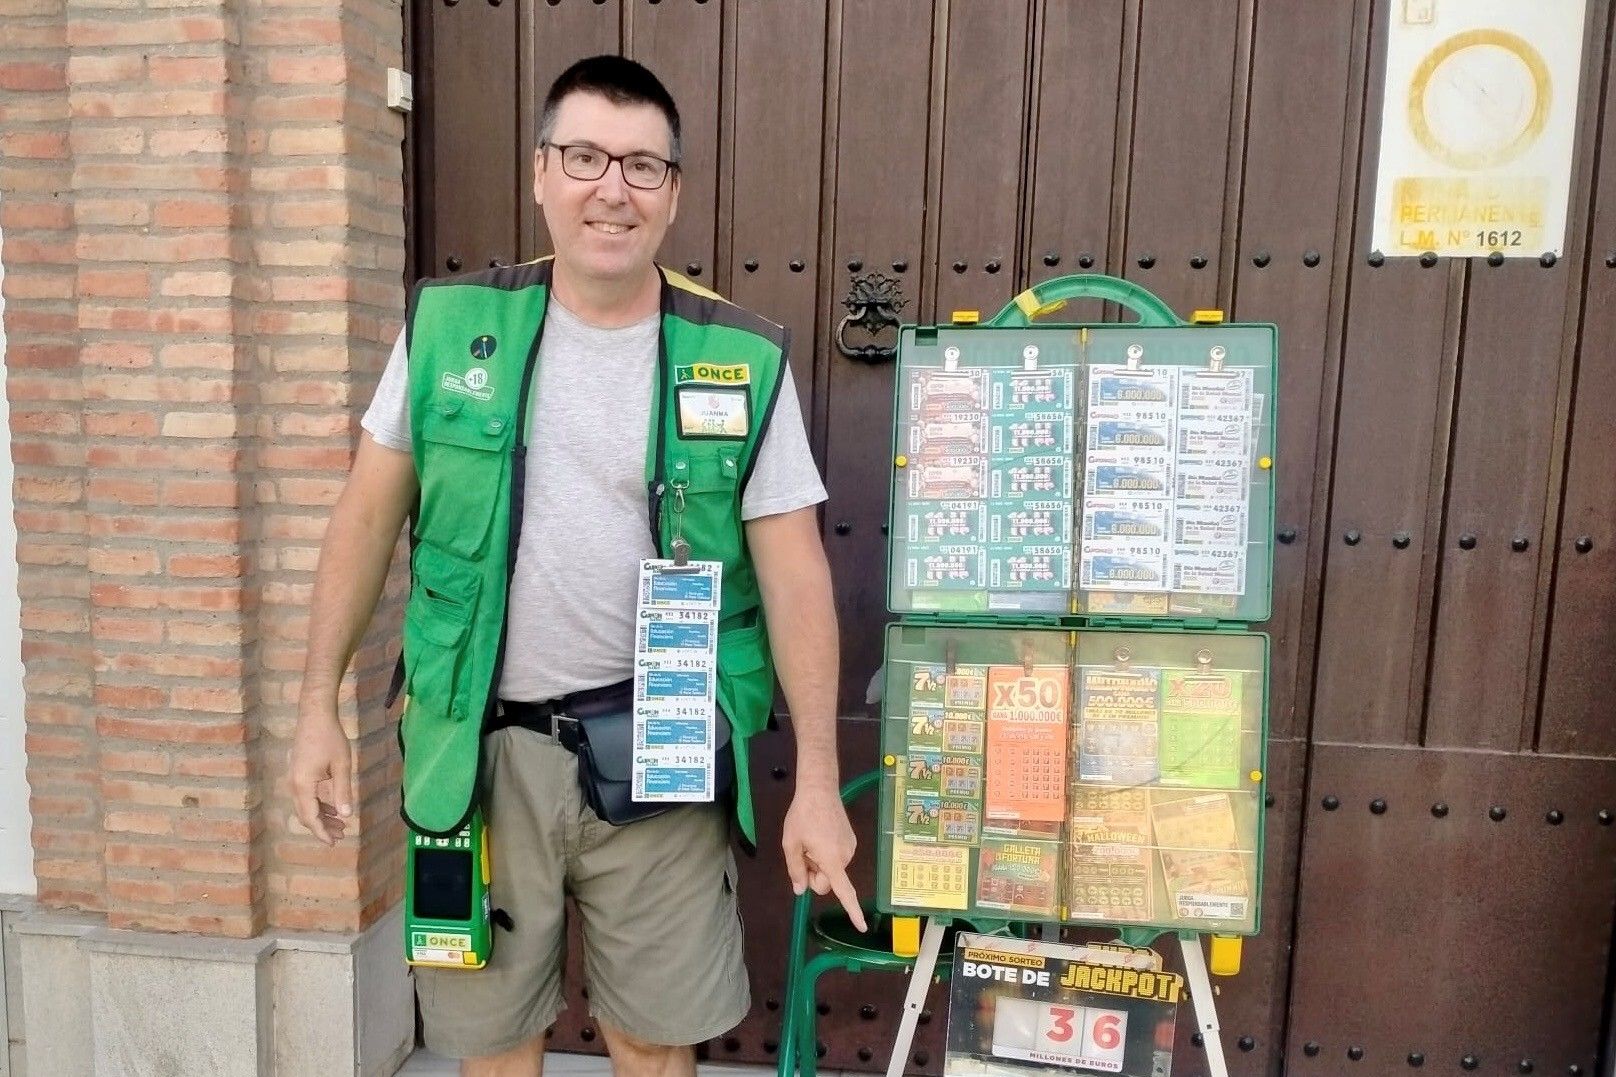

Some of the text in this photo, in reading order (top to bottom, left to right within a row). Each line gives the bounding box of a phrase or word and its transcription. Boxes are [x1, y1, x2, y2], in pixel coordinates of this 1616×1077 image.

[1477, 230, 1522, 246] 1612
[697, 366, 745, 380] ONCE
[679, 611, 708, 619] 34182
[1010, 711, 1062, 722] 1.000.000€
[1003, 844, 1041, 856] GALLETA
[430, 937, 466, 947] ONCE
[1009, 957, 1043, 967] SORTEO
[963, 961, 1050, 987] BOTE DE
[1060, 963, 1173, 999] JACKPOT
[1029, 1052, 1119, 1070] MILLONES DE EUROS
